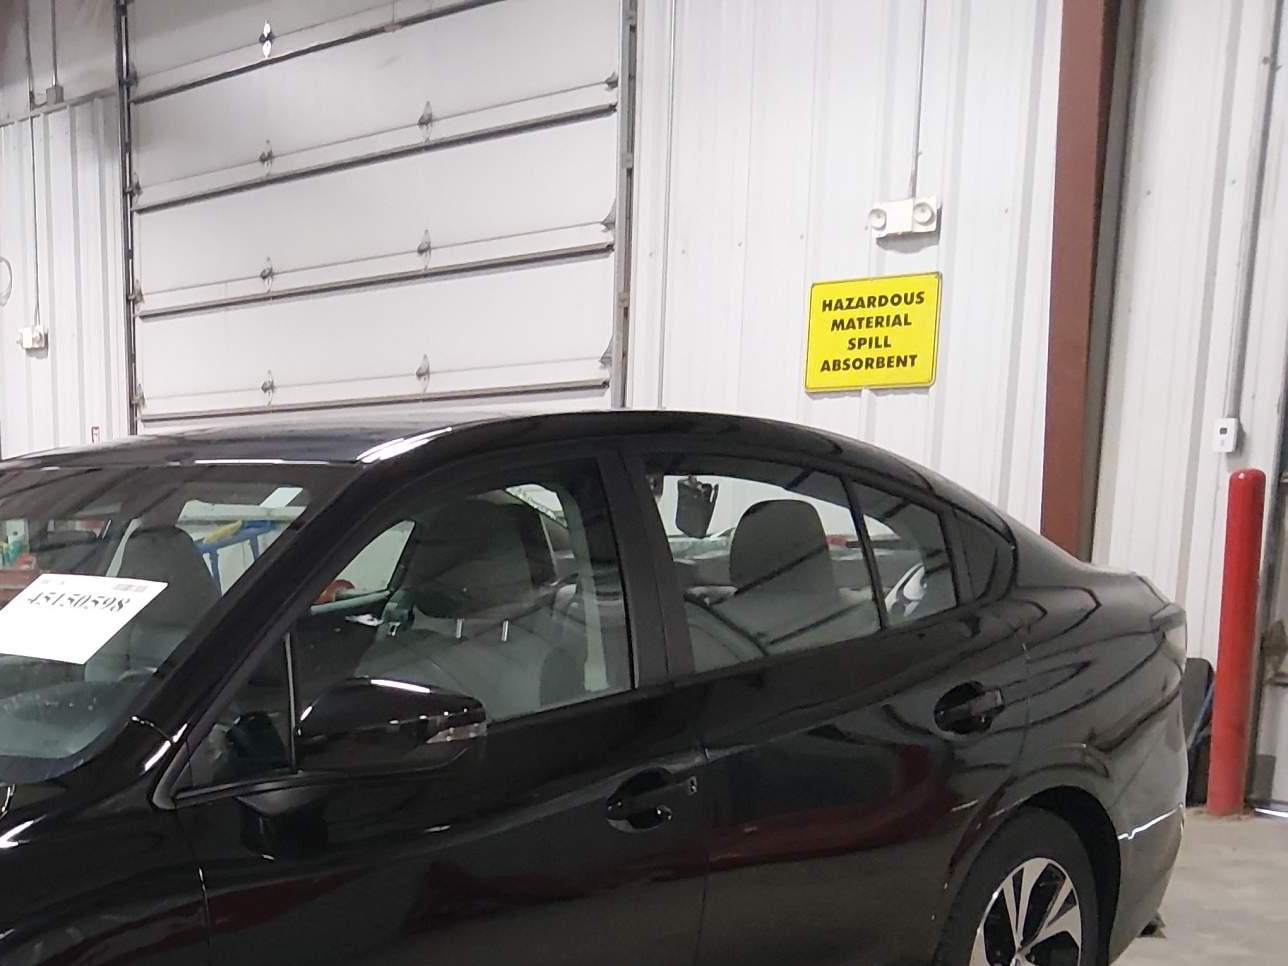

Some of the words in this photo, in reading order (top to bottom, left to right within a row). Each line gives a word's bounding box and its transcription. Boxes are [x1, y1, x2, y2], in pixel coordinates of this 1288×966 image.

[822, 291, 925, 312] HAZARDOUS
[831, 313, 912, 332] MATERIAL
[847, 335, 892, 350] SPILL
[820, 354, 918, 372] ABSORBENT
[28, 591, 130, 612] 45150598
